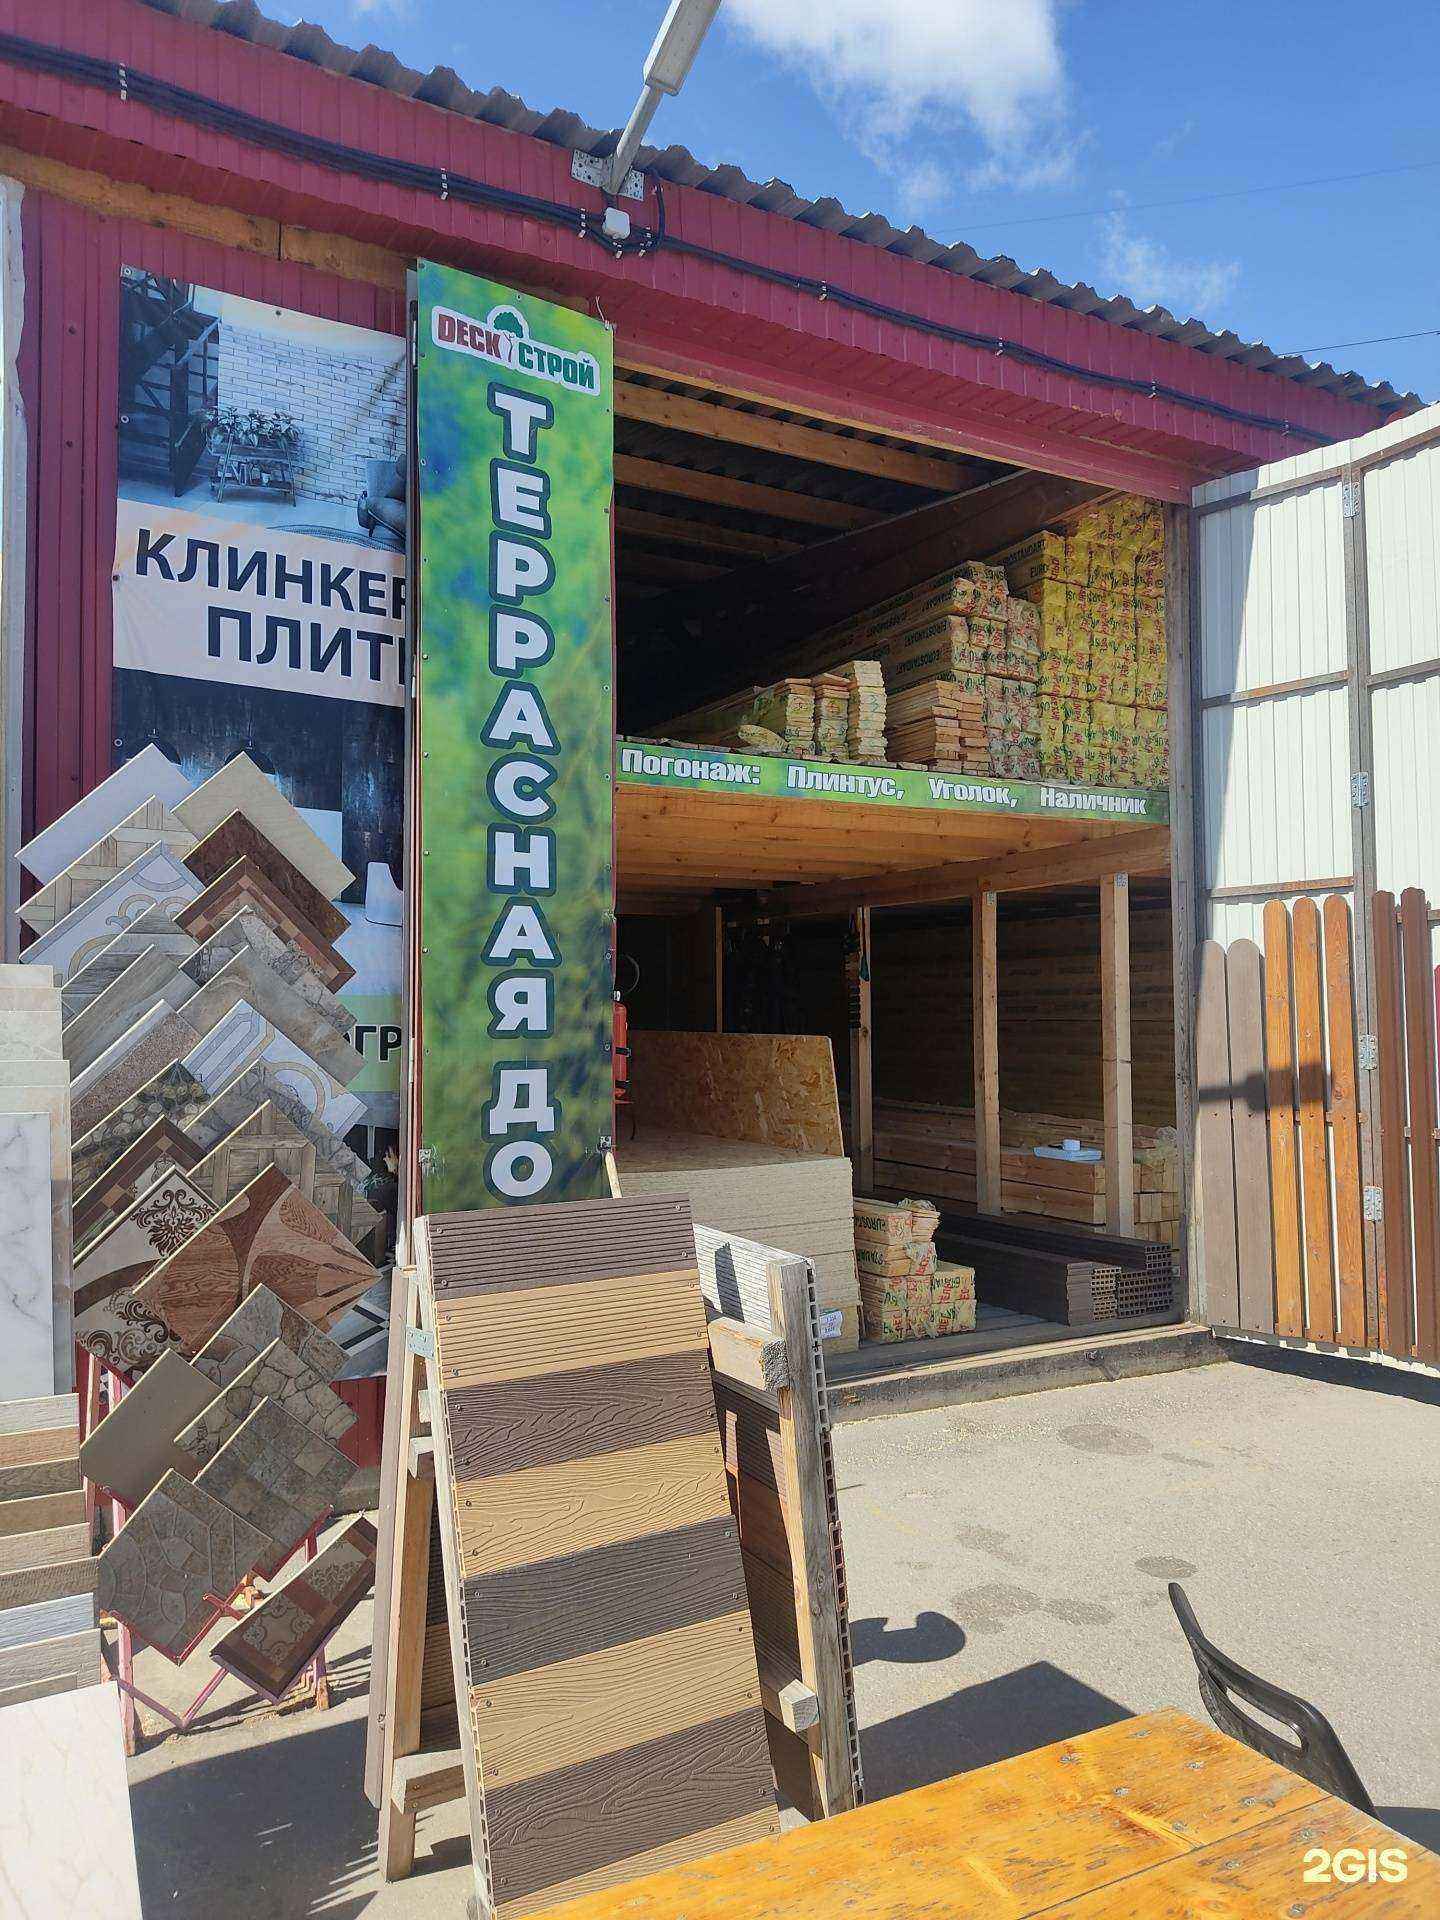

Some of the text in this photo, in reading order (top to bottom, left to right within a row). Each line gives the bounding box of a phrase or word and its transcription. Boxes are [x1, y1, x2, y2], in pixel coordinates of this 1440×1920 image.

[518, 341, 595, 390] СТРОЙ
[208, 605, 406, 686] ПЛИТ
[481, 382, 562, 1040] ТЕРРАСНАЯ
[621, 748, 1148, 815] Погонаж: Плинтус, Уголок, Наличник
[343, 1025, 402, 1062] ГР
